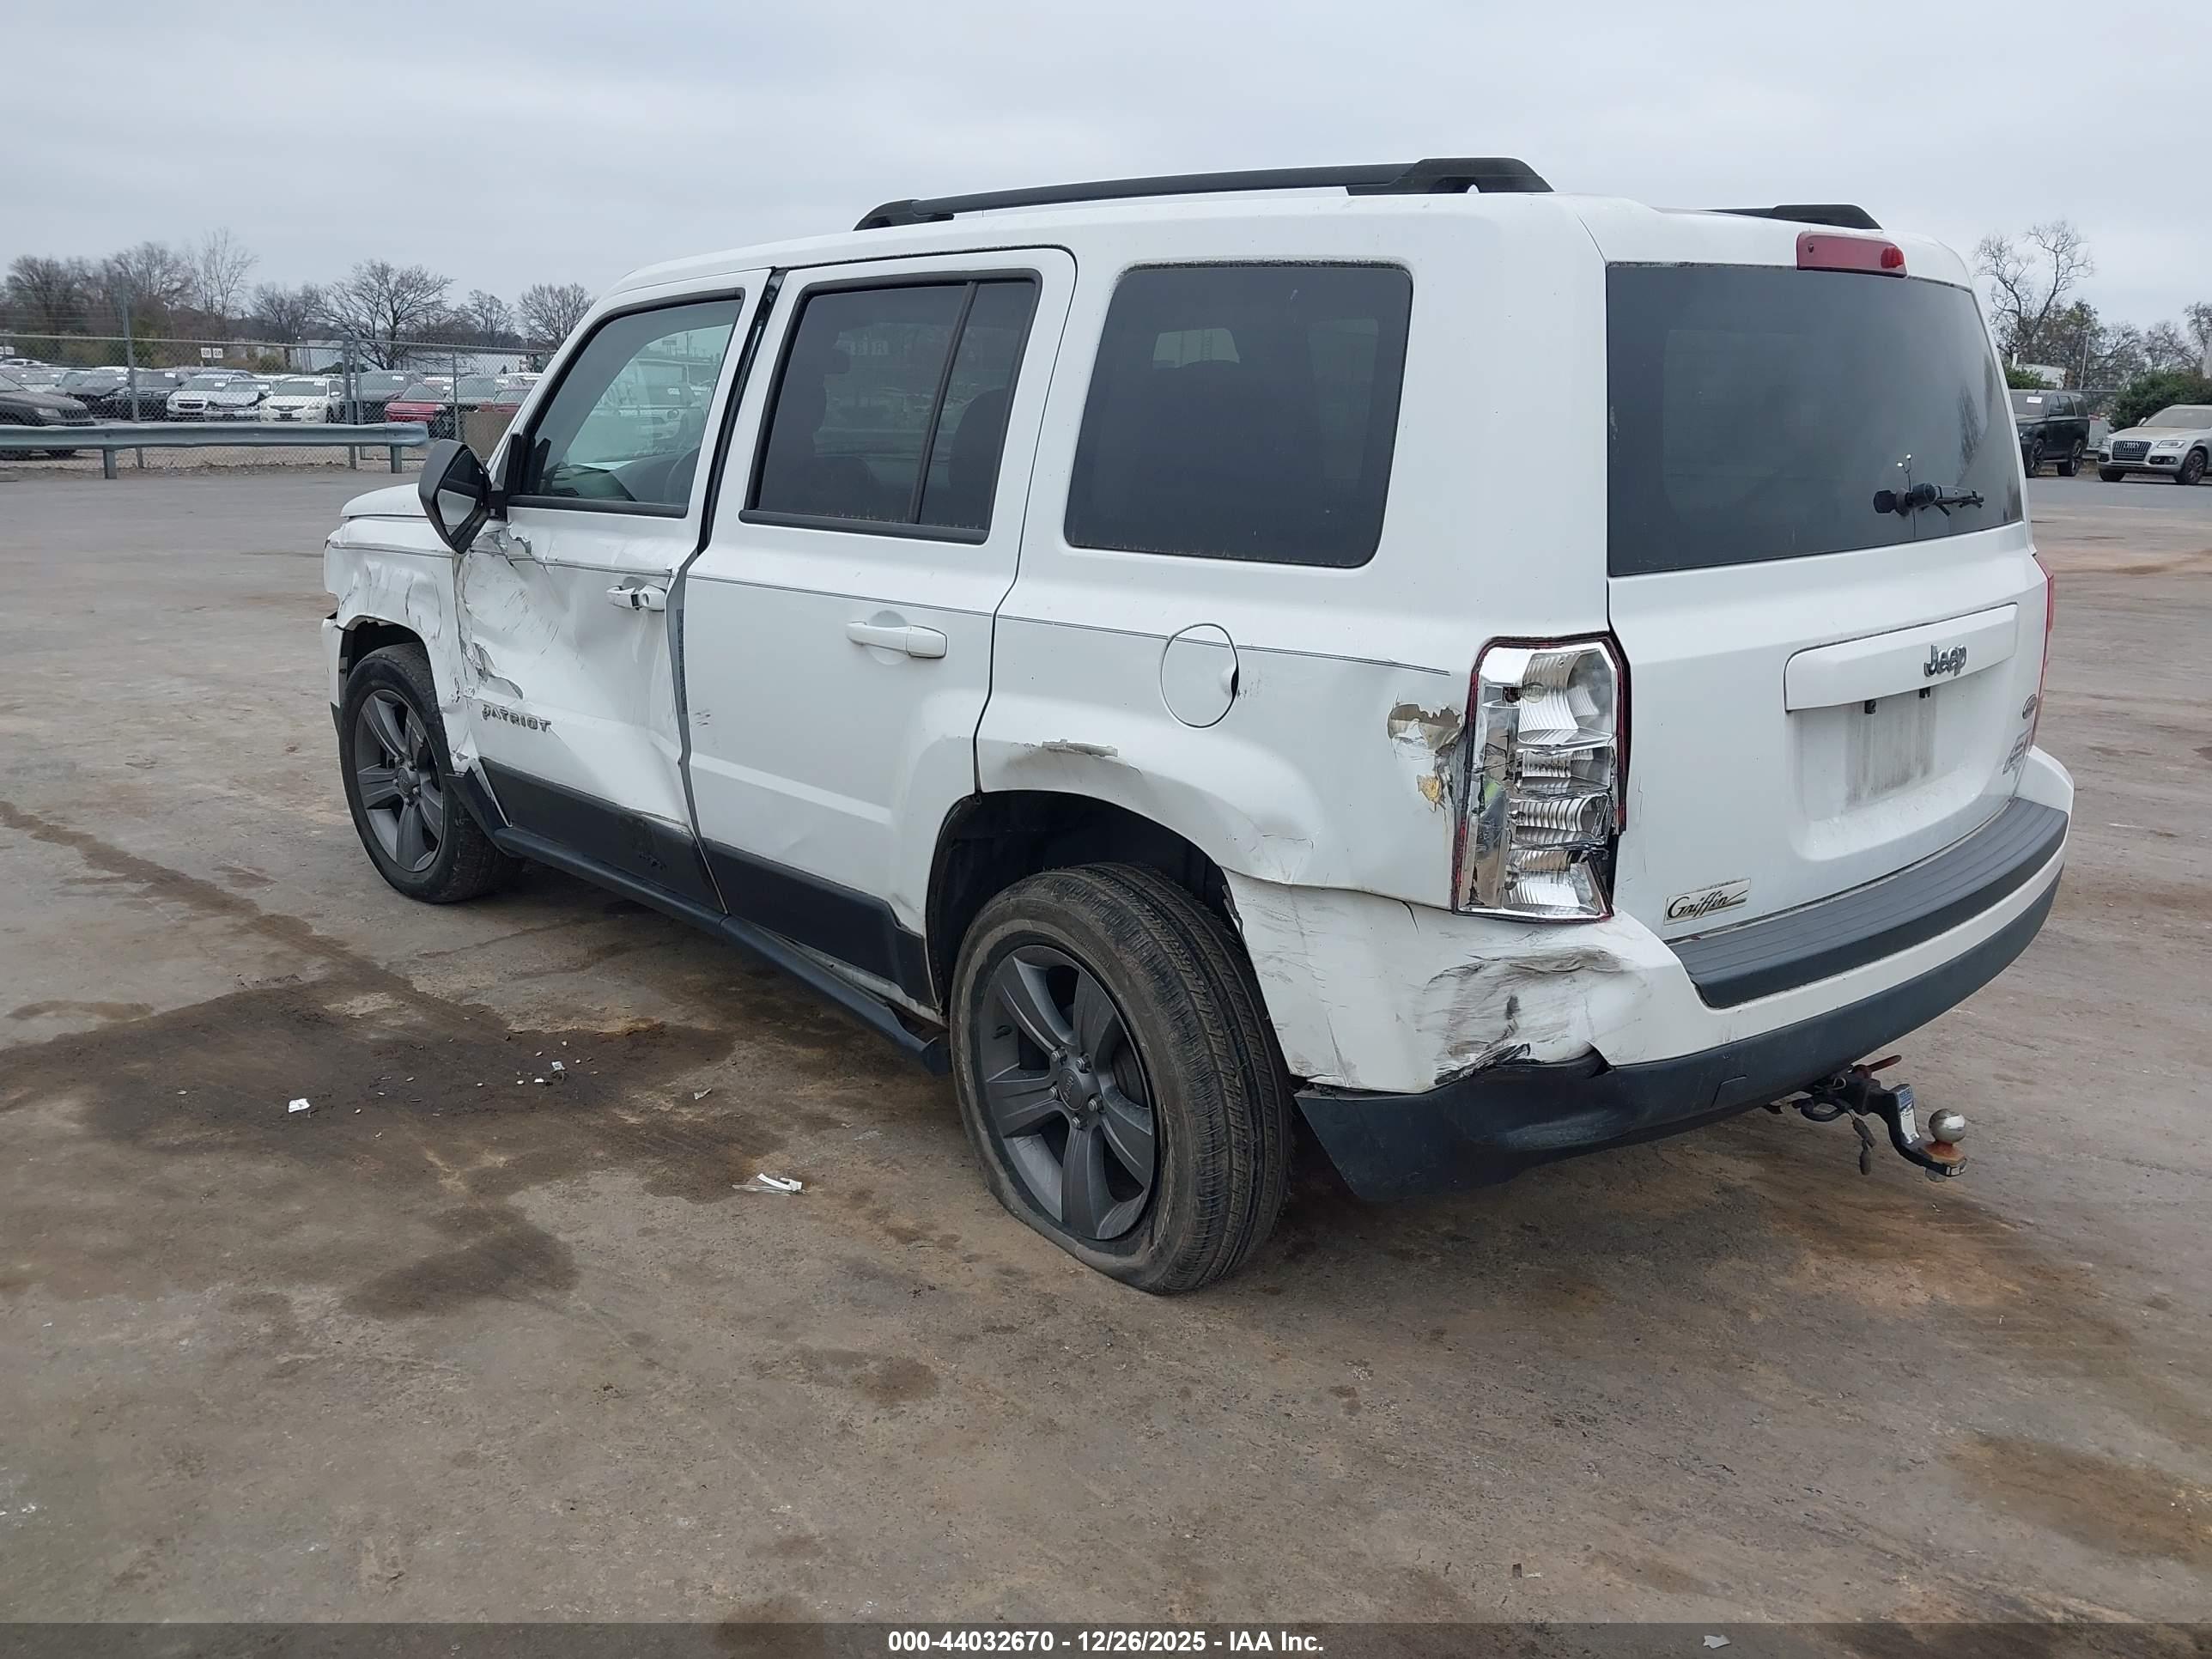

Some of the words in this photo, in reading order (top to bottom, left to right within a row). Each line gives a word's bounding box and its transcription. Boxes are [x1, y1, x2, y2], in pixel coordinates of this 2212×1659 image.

[1923, 644, 1967, 678] Jeep
[482, 703, 552, 733] PATRIOT
[1667, 890, 1731, 919] Griffin
